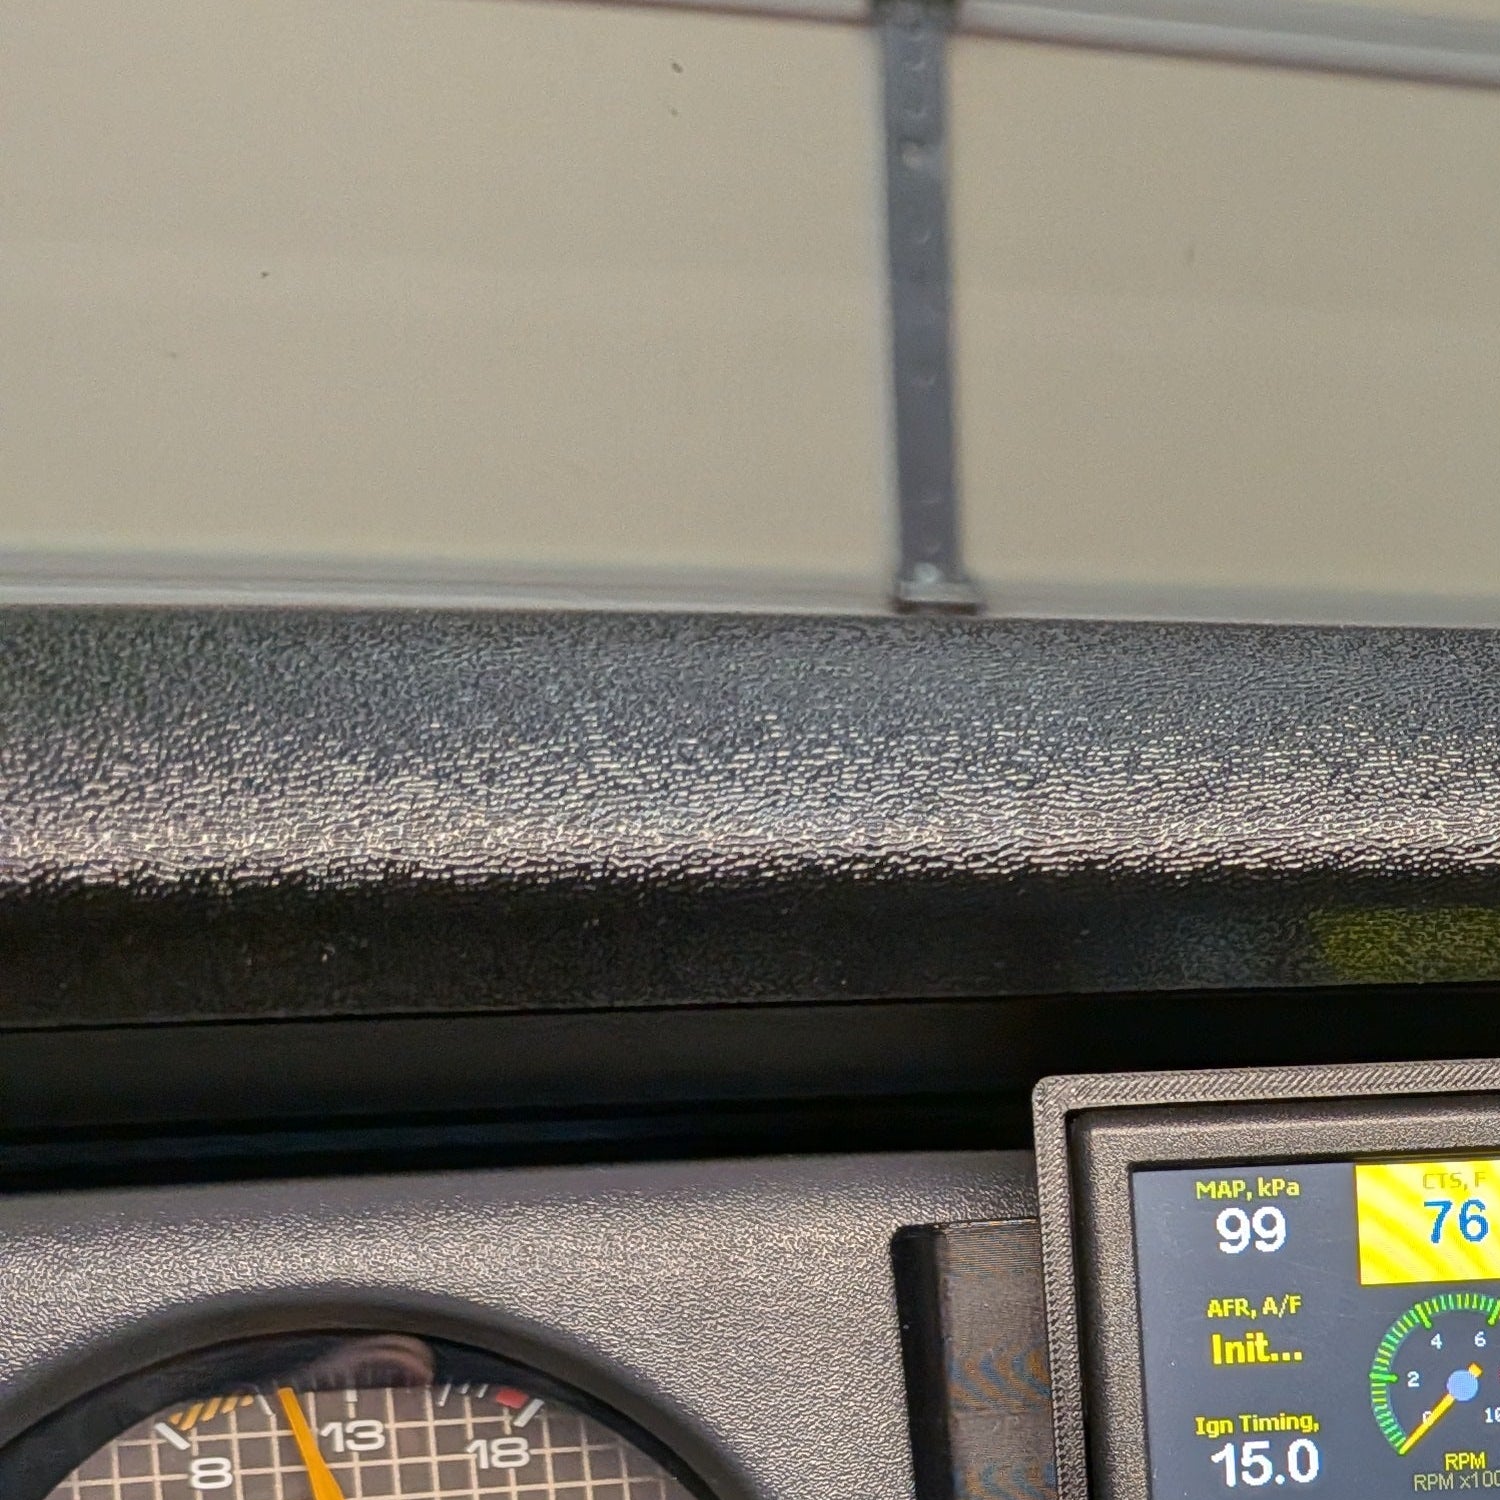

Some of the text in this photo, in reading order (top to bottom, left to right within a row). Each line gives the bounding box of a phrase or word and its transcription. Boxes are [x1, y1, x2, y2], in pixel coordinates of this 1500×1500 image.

[1195, 1177, 1301, 1201] MAP, kPa
[1422, 1171, 1487, 1191] CTS, F
[1215, 1206, 1287, 1254] 99
[1423, 1199, 1489, 1244] 76
[1207, 1294, 1302, 1319] AFR, A/F
[1211, 1331, 1303, 1365] Init...
[1430, 1333, 1443, 1350] 4
[1474, 1331, 1487, 1348] 6
[1407, 1371, 1420, 1388] 2
[320, 1418, 386, 1453] 13
[1195, 1412, 1320, 1439] Ign Timing,
[465, 1436, 531, 1470] 18
[1210, 1438, 1320, 1488] 15.0
[1444, 1452, 1486, 1471] RPM
[189, 1456, 234, 1490] 8
[1413, 1473, 1454, 1491] RPM
